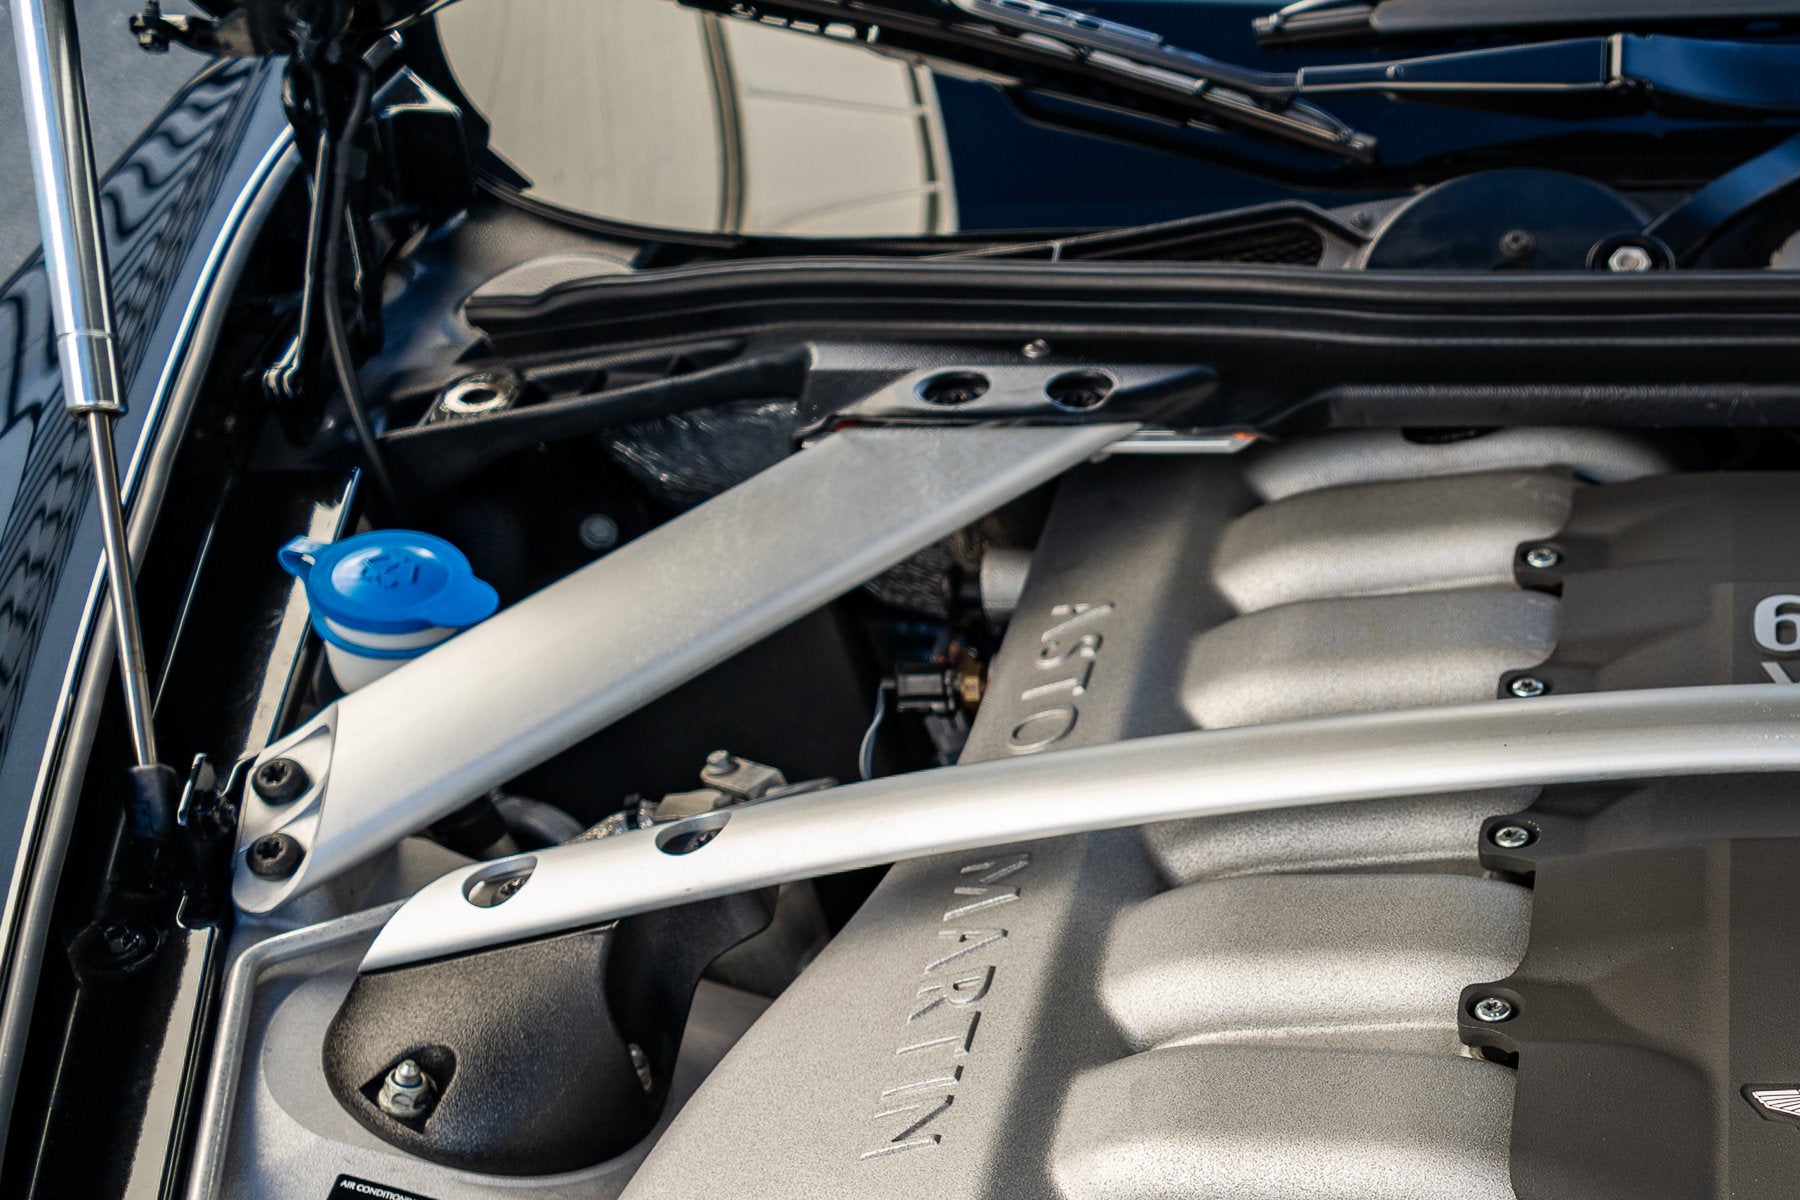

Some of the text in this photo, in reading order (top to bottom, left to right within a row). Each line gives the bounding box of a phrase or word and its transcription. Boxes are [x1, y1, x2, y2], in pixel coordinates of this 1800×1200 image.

[1007, 602, 1116, 755] ASTO
[860, 853, 1029, 1161] MARTIN
[340, 1180, 357, 1190] AIR
